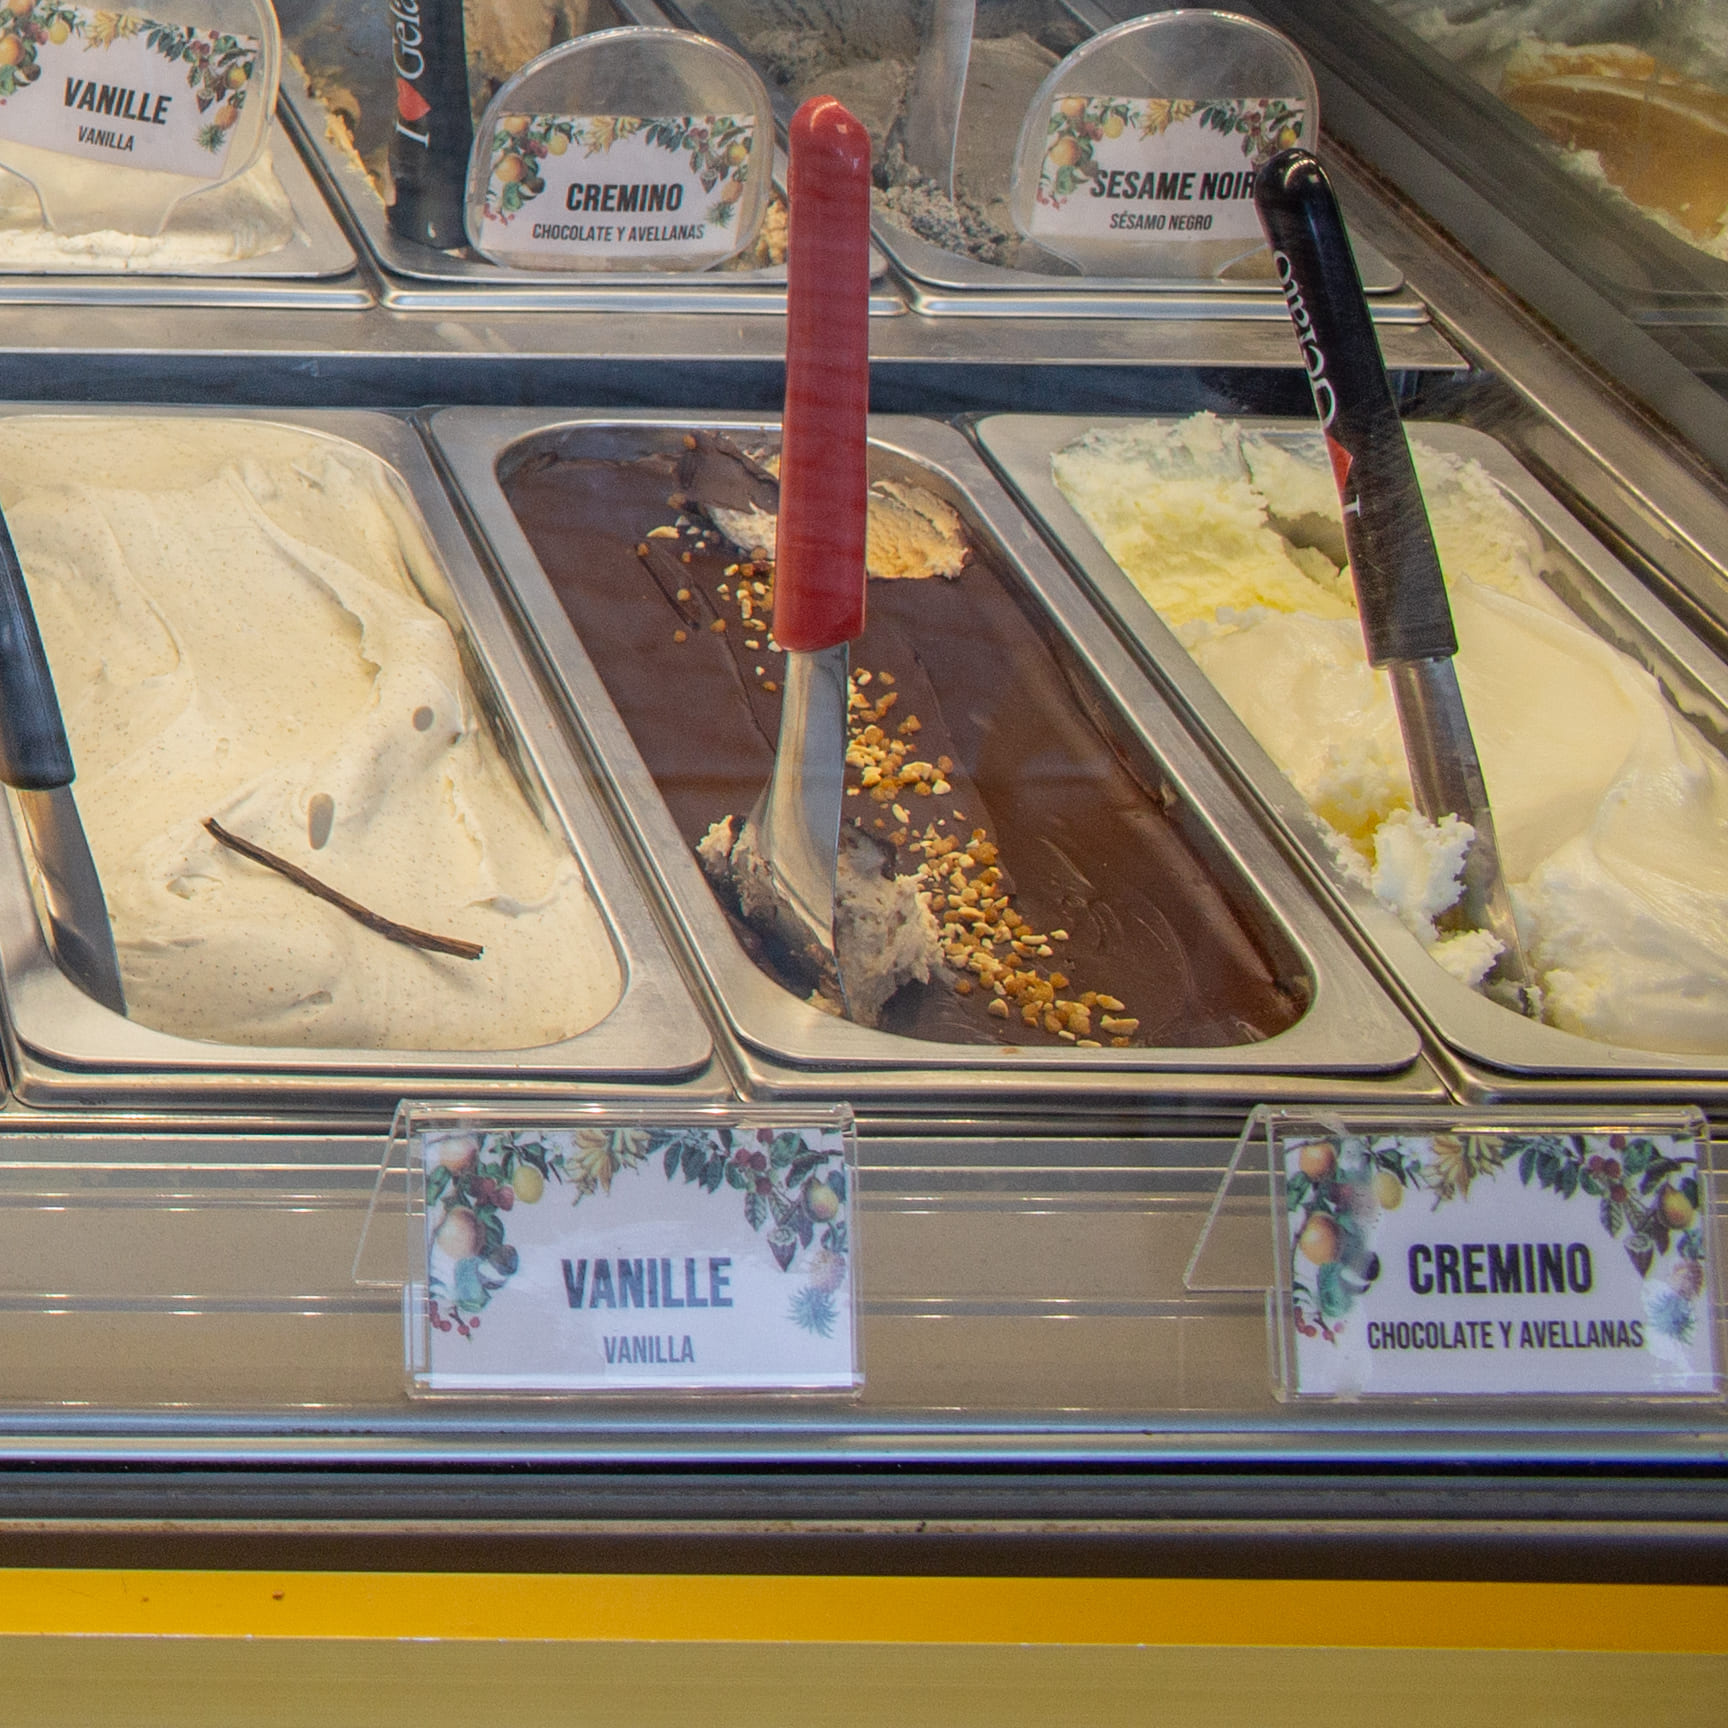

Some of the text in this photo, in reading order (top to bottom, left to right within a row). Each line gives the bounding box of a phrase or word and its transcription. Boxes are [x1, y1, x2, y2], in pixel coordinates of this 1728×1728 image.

[62, 75, 174, 128] VANILLE
[77, 124, 135, 154] VANILLA
[565, 181, 685, 214] CREMINO
[1090, 169, 1197, 200] SESAME
[531, 222, 706, 243] CHOCOLATE Y AVELLANAS
[1109, 210, 1213, 231] SÉSAMO NEGRO
[561, 1256, 734, 1309] VANILLE
[1408, 1242, 1593, 1295] CREMINO
[603, 1334, 695, 1364] VANILLA
[1367, 1321, 1645, 1350] CHOCOLATE Y AVELLANAS
